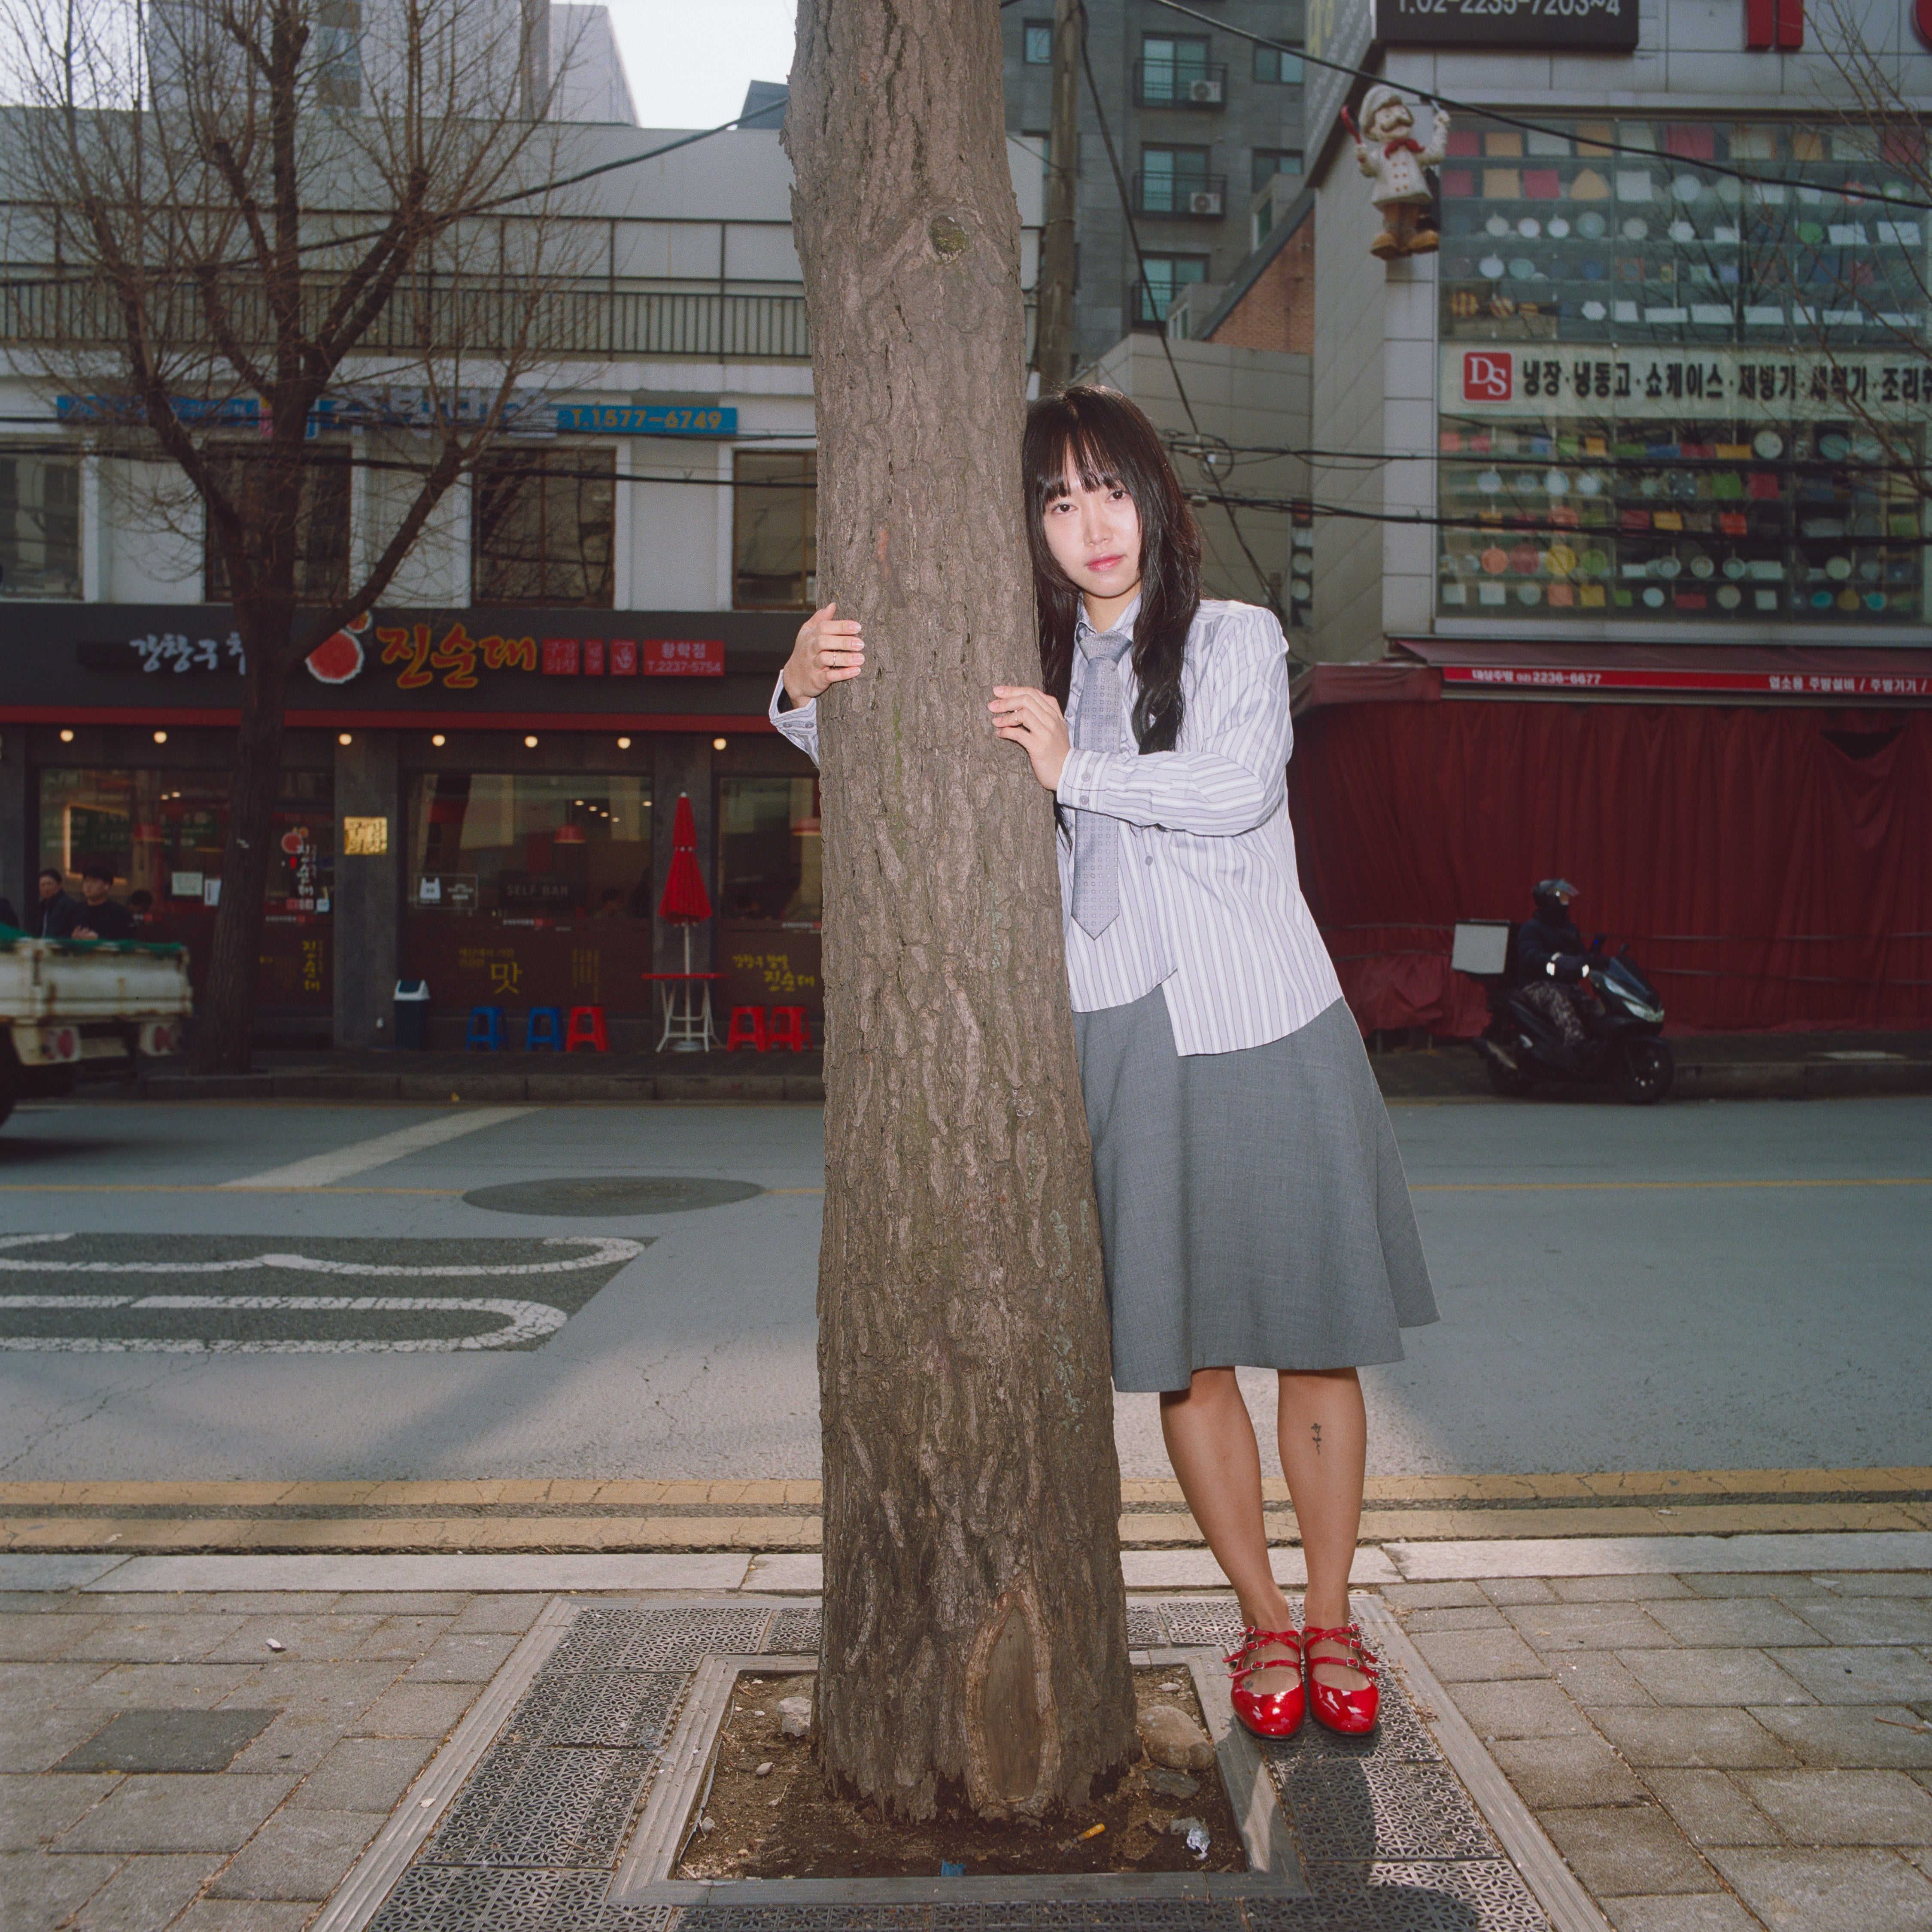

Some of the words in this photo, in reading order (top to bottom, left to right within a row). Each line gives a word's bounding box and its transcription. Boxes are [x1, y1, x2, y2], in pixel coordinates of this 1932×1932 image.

[1469, 357, 1507, 396] DS
[571, 409, 722, 428] T.1577-6749
[490, 961, 523, 995] 맛
